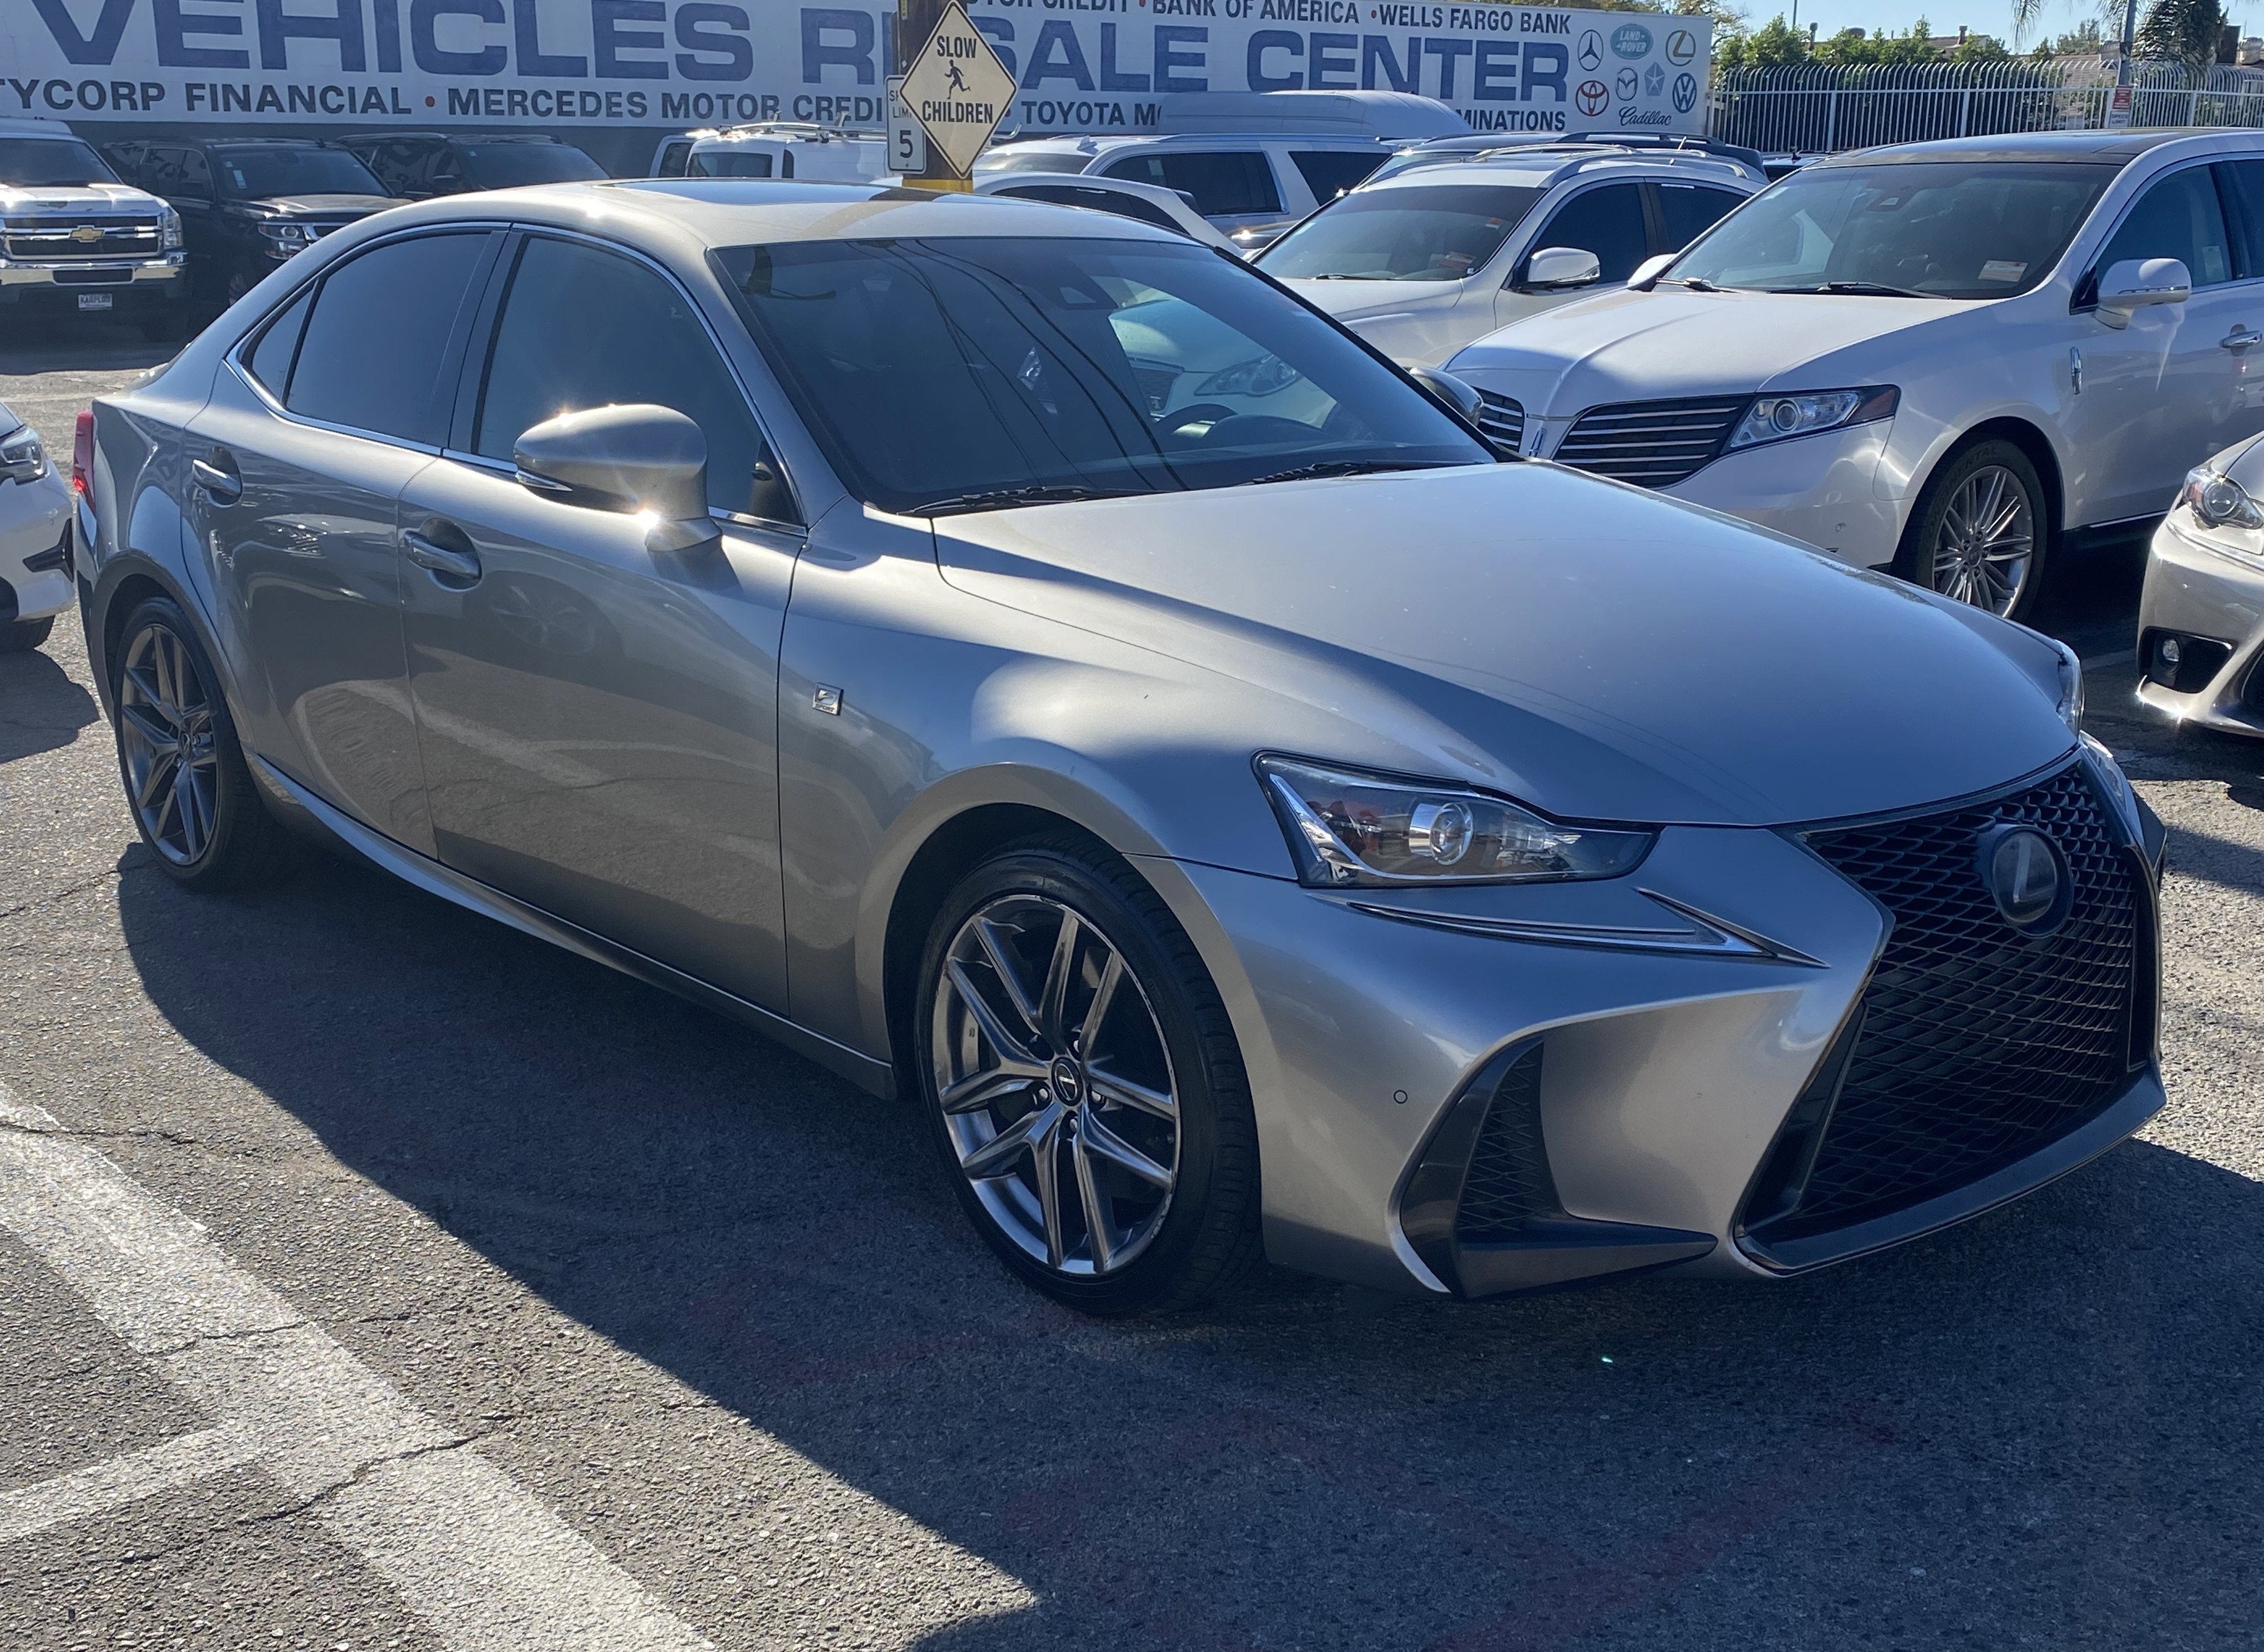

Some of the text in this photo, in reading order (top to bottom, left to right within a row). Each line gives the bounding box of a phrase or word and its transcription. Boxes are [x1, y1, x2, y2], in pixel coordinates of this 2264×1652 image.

[1153, 0, 1216, 16] BANK
[1225, 0, 1253, 18] OF
[1260, 0, 1360, 24] AMERICA
[1380, 5, 1443, 28] WELLS
[1450, 8, 1513, 31] FARGO
[1520, 12, 1571, 34] BANK
[31, 0, 1569, 102] VEHICLES RALE CENTER
[937, 35, 977, 59] SLOW
[0, 79, 166, 111] YCORP
[185, 82, 412, 115] FINANCIAL
[447, 87, 648, 119] MERCEDES
[661, 92, 780, 120] MOTOR
[793, 94, 882, 122] CREDI
[1021, 101, 1126, 126] TOYOTA
[922, 100, 993, 124] CHILDREN
[1619, 106, 1672, 126] Cadillac
[900, 129, 913, 159] 5
